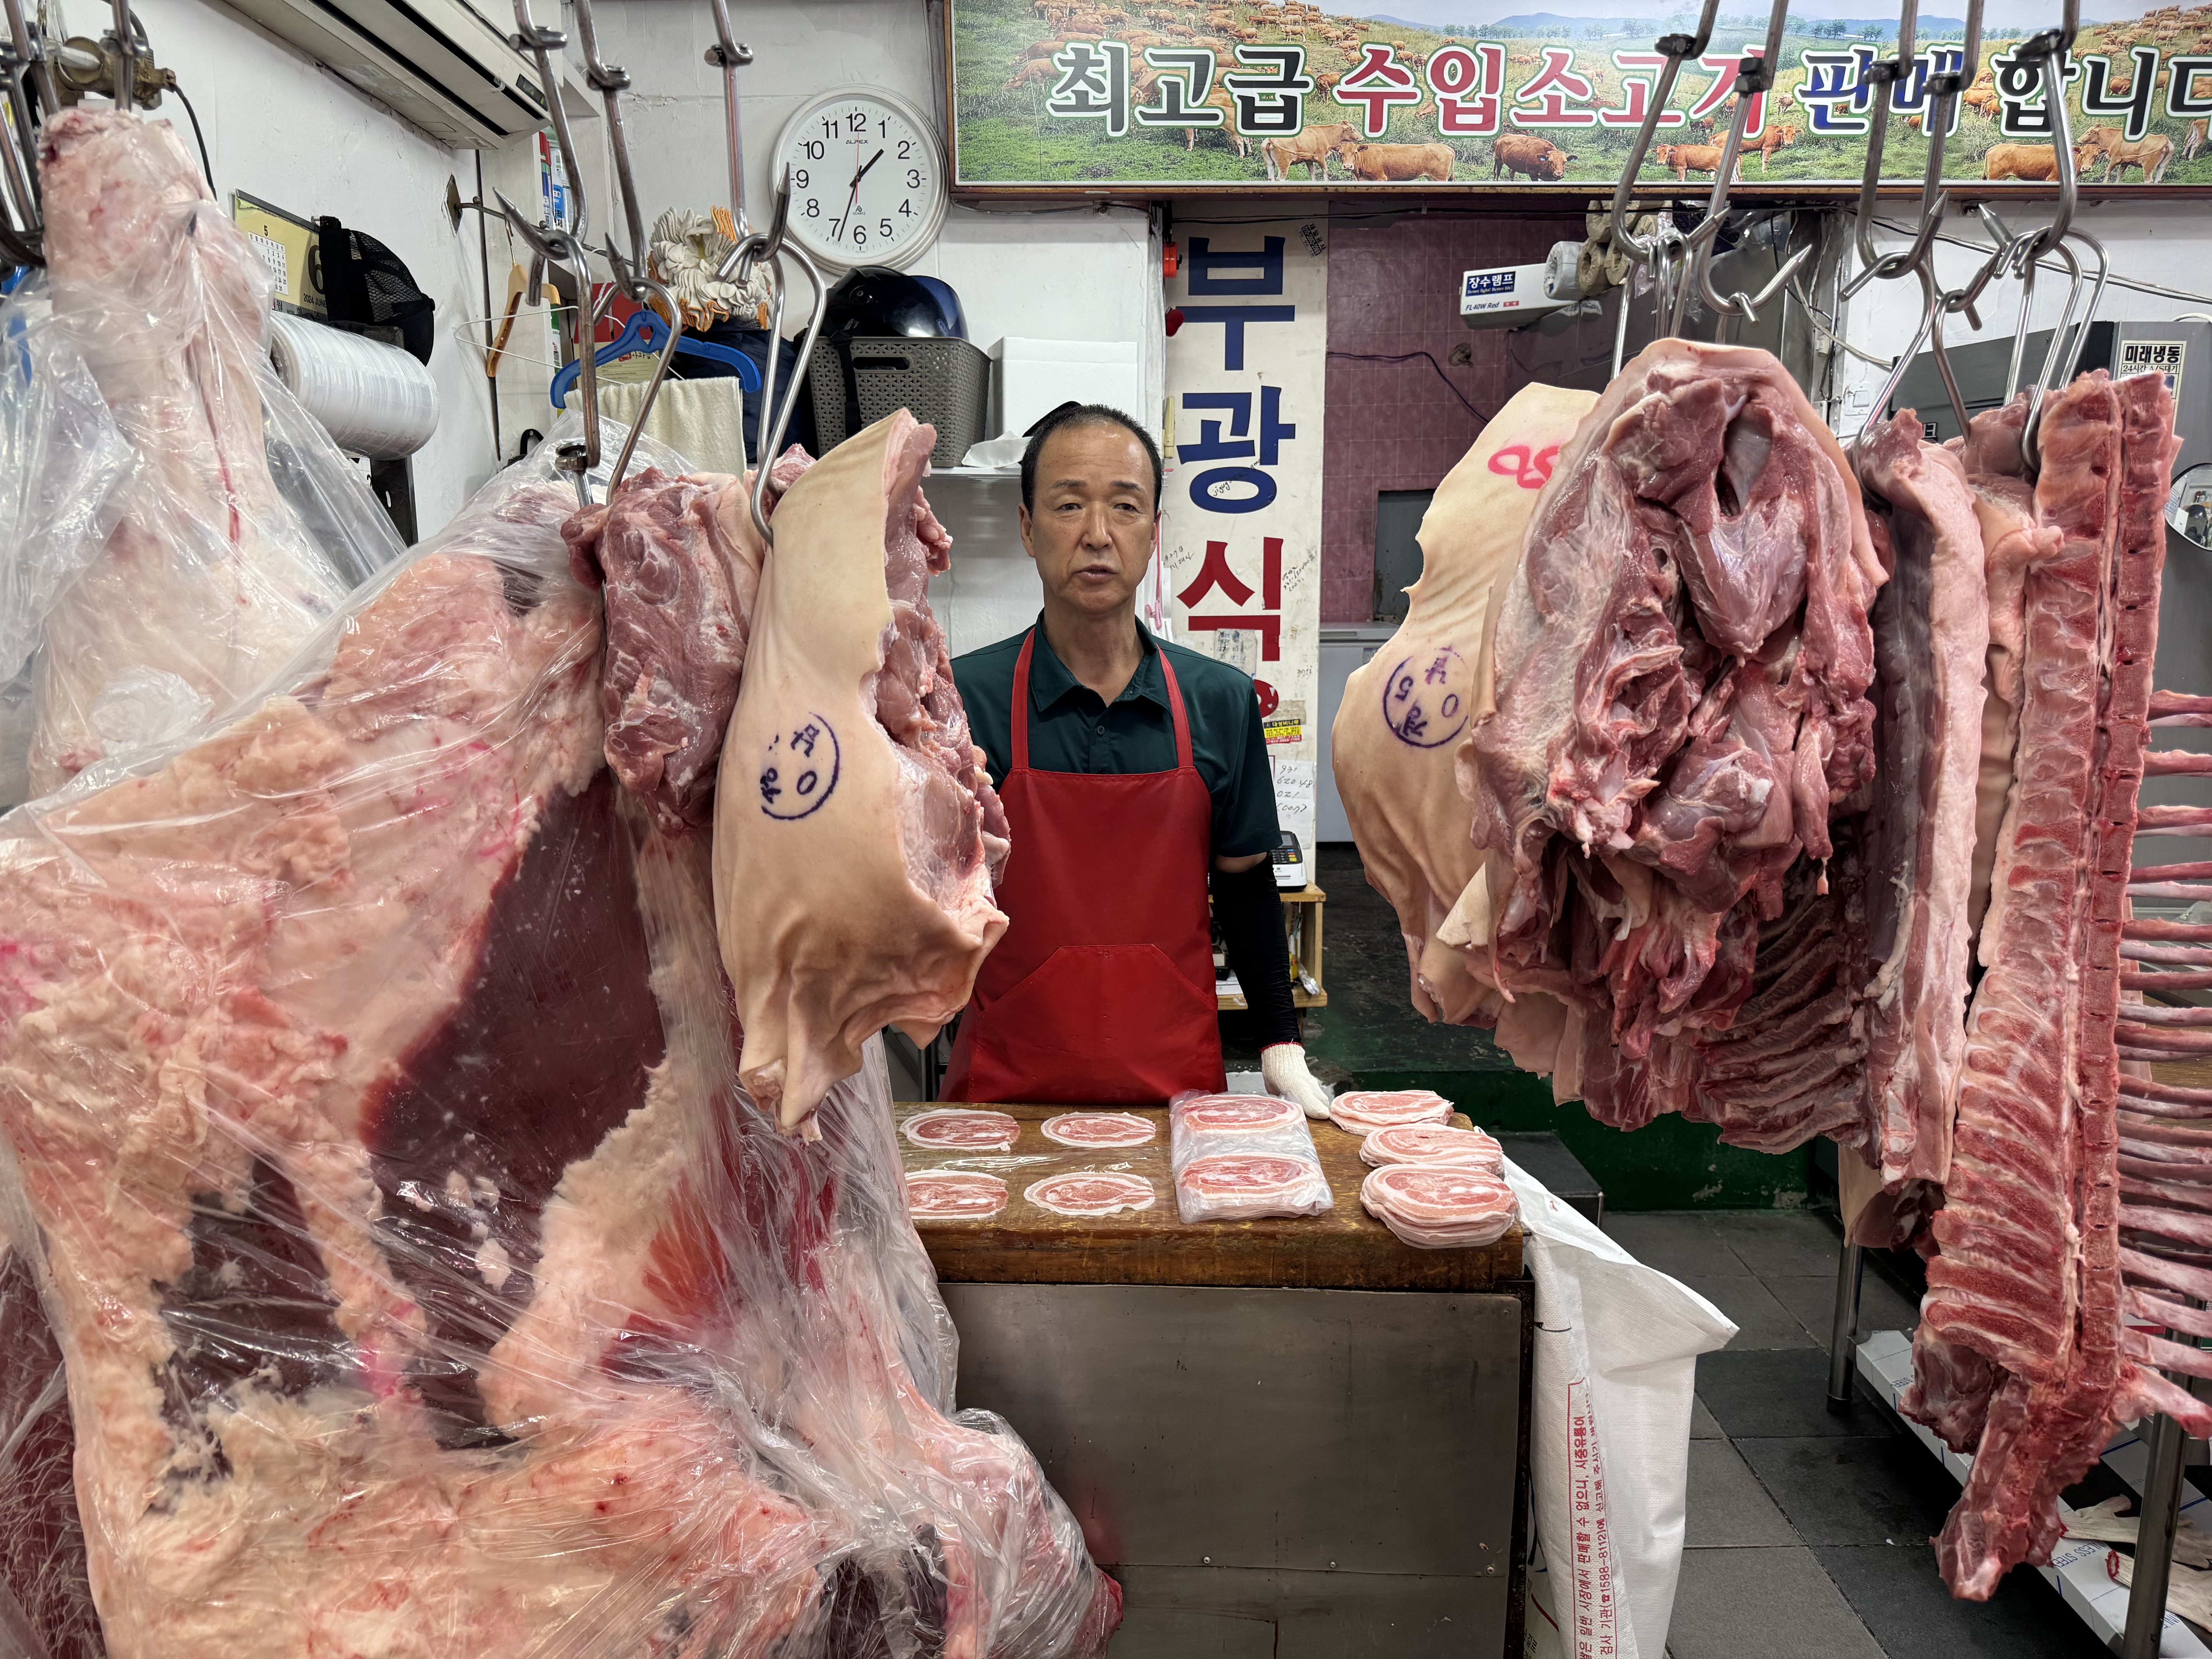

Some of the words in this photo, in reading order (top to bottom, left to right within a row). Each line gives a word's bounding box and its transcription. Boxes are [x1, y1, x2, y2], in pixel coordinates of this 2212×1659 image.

[1049, 40, 1314, 136] 최고급
[1333, 41, 1767, 139] 수입소고기
[1797, 43, 1964, 137] 판매
[822, 120, 838, 139] 11
[845, 113, 866, 132] 12
[878, 120, 885, 139] 1
[802, 140, 824, 160] 10
[898, 140, 910, 159] 2
[796, 169, 809, 189] 9
[907, 169, 920, 189] 3
[806, 198, 820, 218] 8
[898, 199, 912, 218] 4
[264, 225, 268, 237] 5
[829, 218, 841, 237] 7
[854, 225, 866, 244] 6
[879, 218, 893, 237] 5
[1468, 274, 1514, 289] 장수램프
[303, 293, 314, 304] 2024
[2125, 345, 2180, 363] 미래냉동
[2123, 365, 2147, 373] 24시간
[1280, 765, 1297, 775] 931
[1299, 779, 1313, 788] 48
[1594, 1480, 1604, 1512] 신고해
[1576, 1516, 1589, 1527] 수
[1576, 1532, 1591, 1564] 판매할
[1578, 1569, 1592, 1609] 시장에서
[1580, 1616, 1592, 1636] 일반
[1600, 1635, 1613, 1655] 검사
